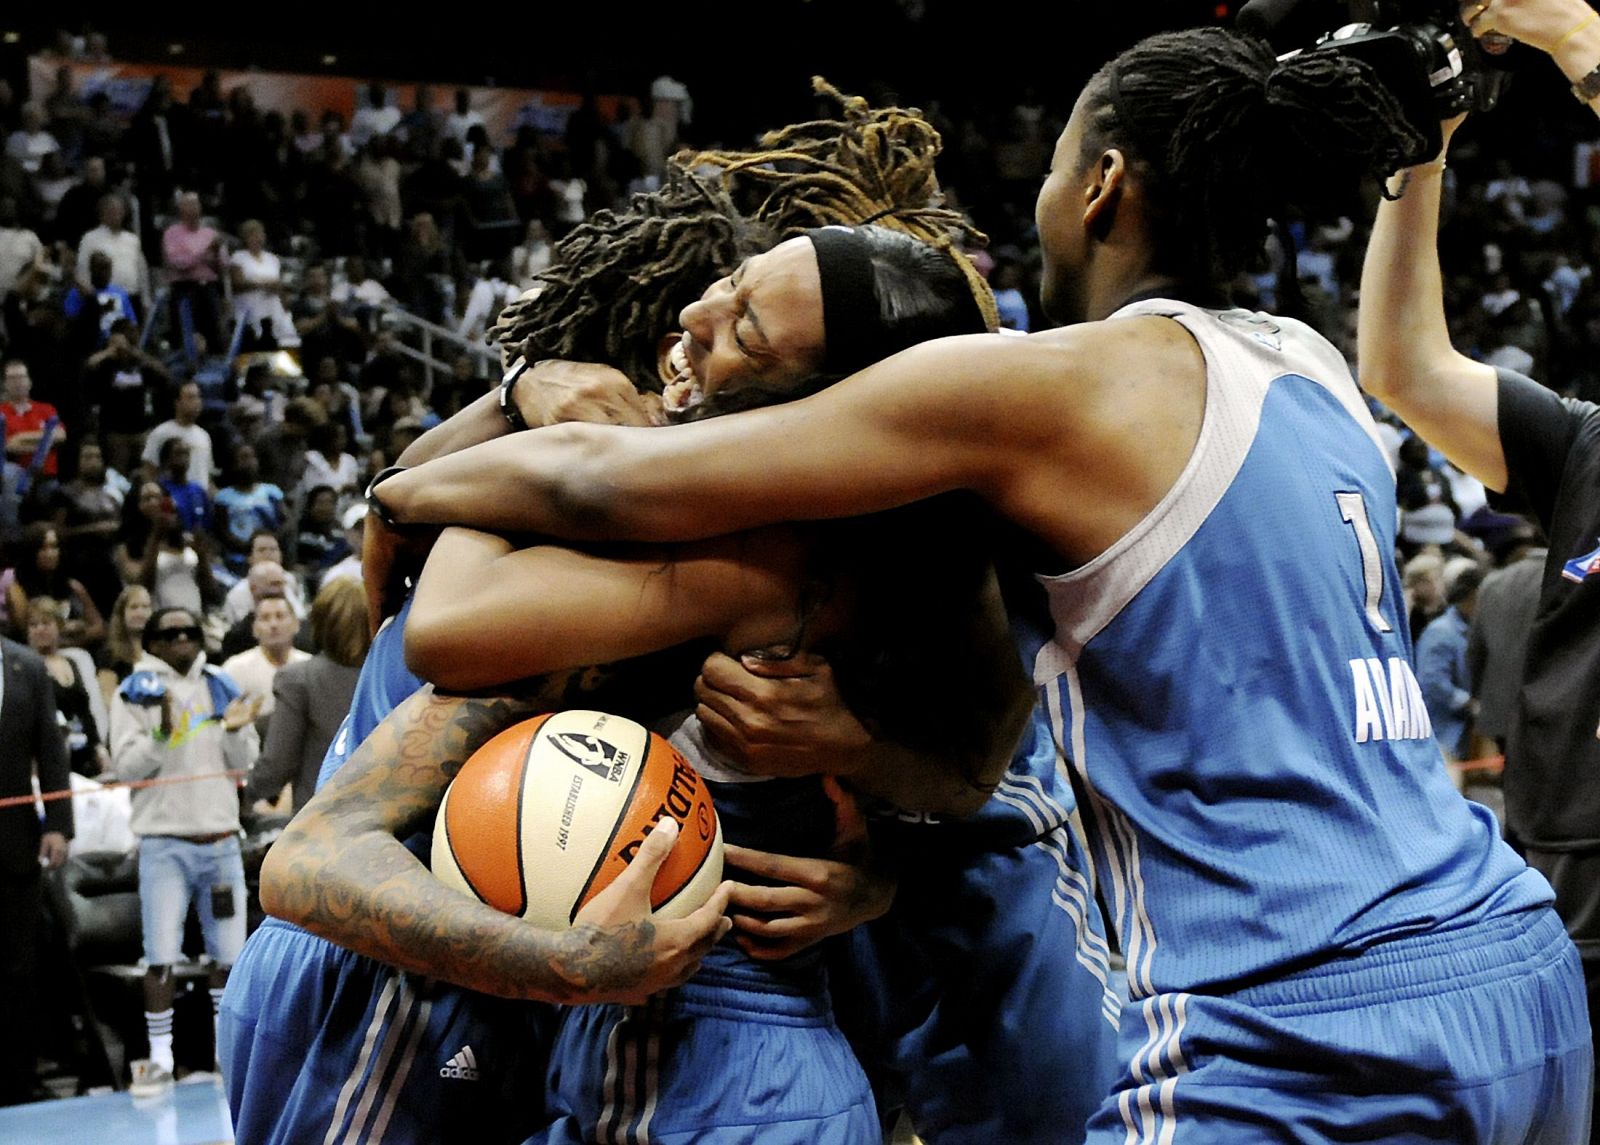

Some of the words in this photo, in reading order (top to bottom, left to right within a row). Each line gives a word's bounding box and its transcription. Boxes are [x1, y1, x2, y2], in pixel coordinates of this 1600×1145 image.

[1334, 490, 1393, 633] 1
[609, 751, 628, 784] WNBA
[562, 775, 583, 827] ESTABLISHED
[556, 827, 570, 852] 1997
